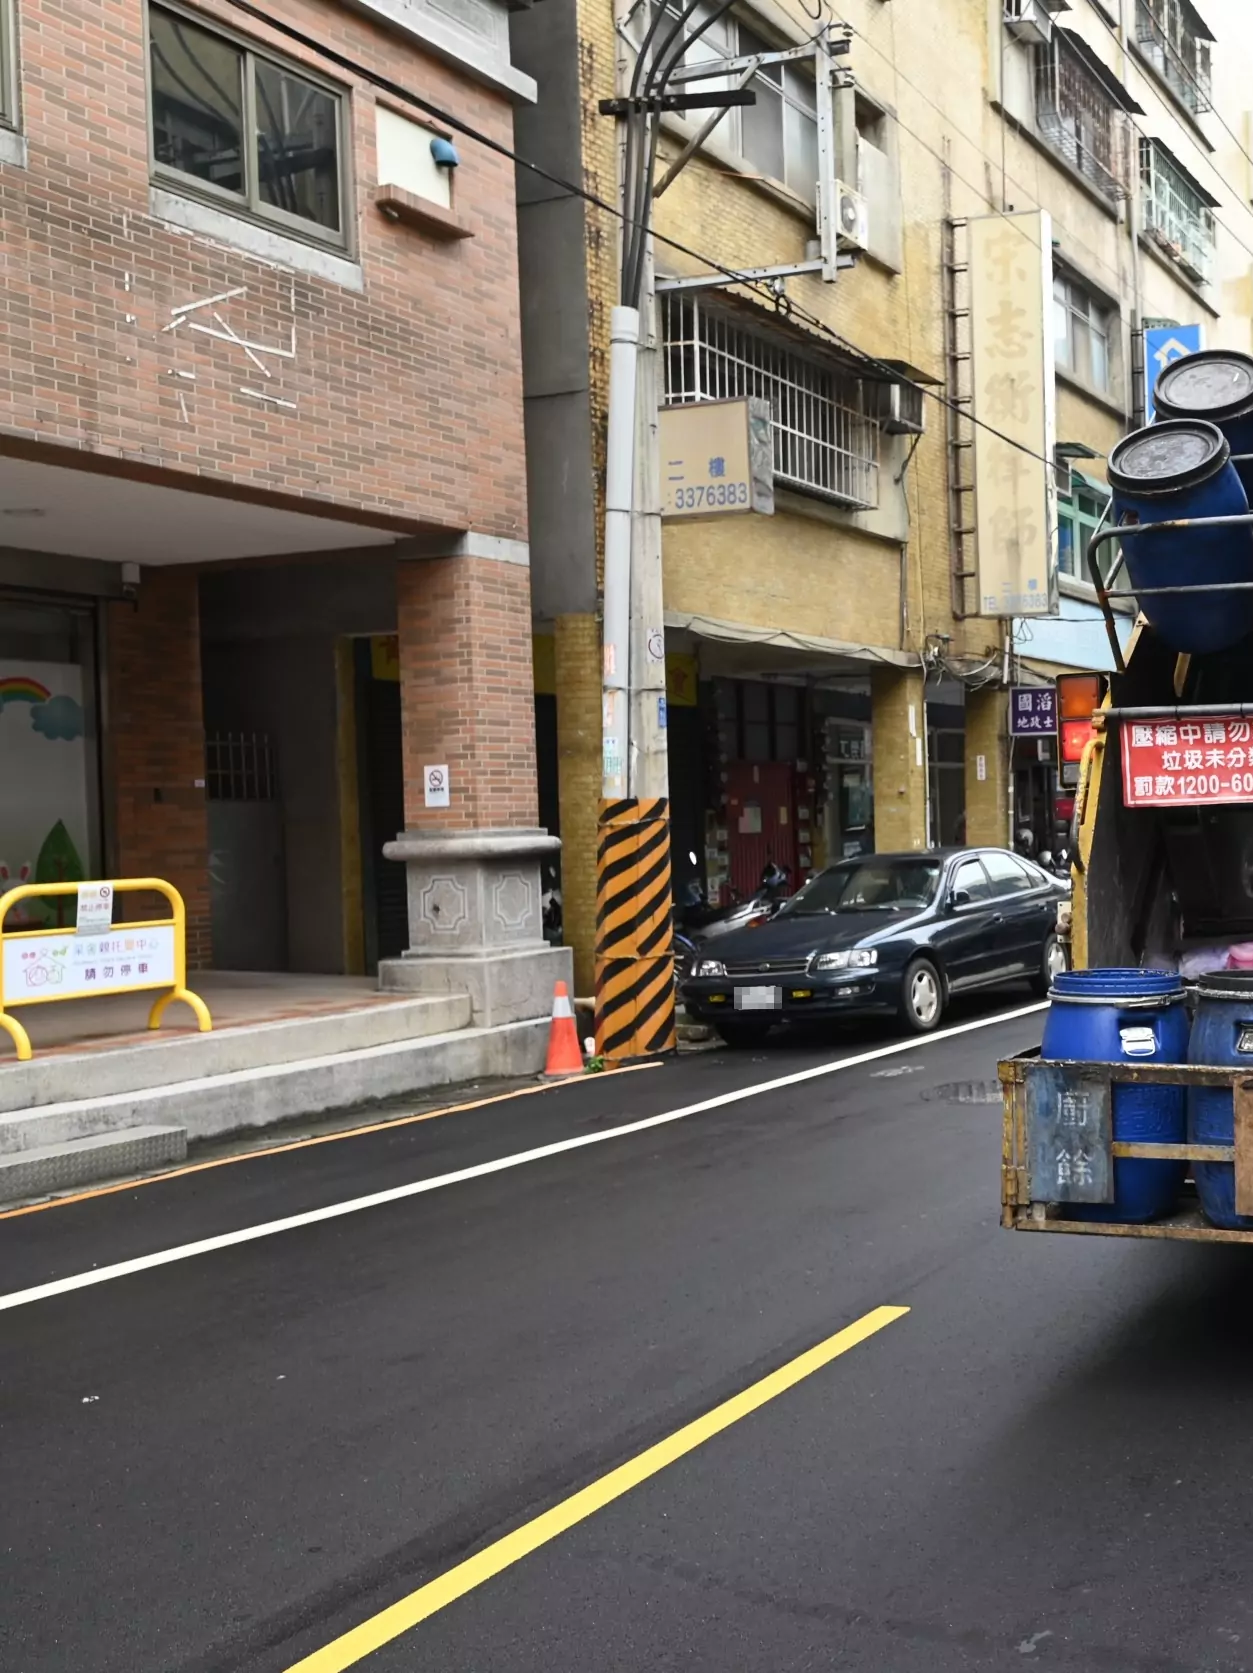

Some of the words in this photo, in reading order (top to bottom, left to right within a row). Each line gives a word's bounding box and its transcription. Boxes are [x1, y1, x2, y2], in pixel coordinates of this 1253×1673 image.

[1017, 715, 1053, 729] 地政士
[84, 963, 149, 981] 請勿停車
[1054, 1090, 1094, 1186] 廚餘
